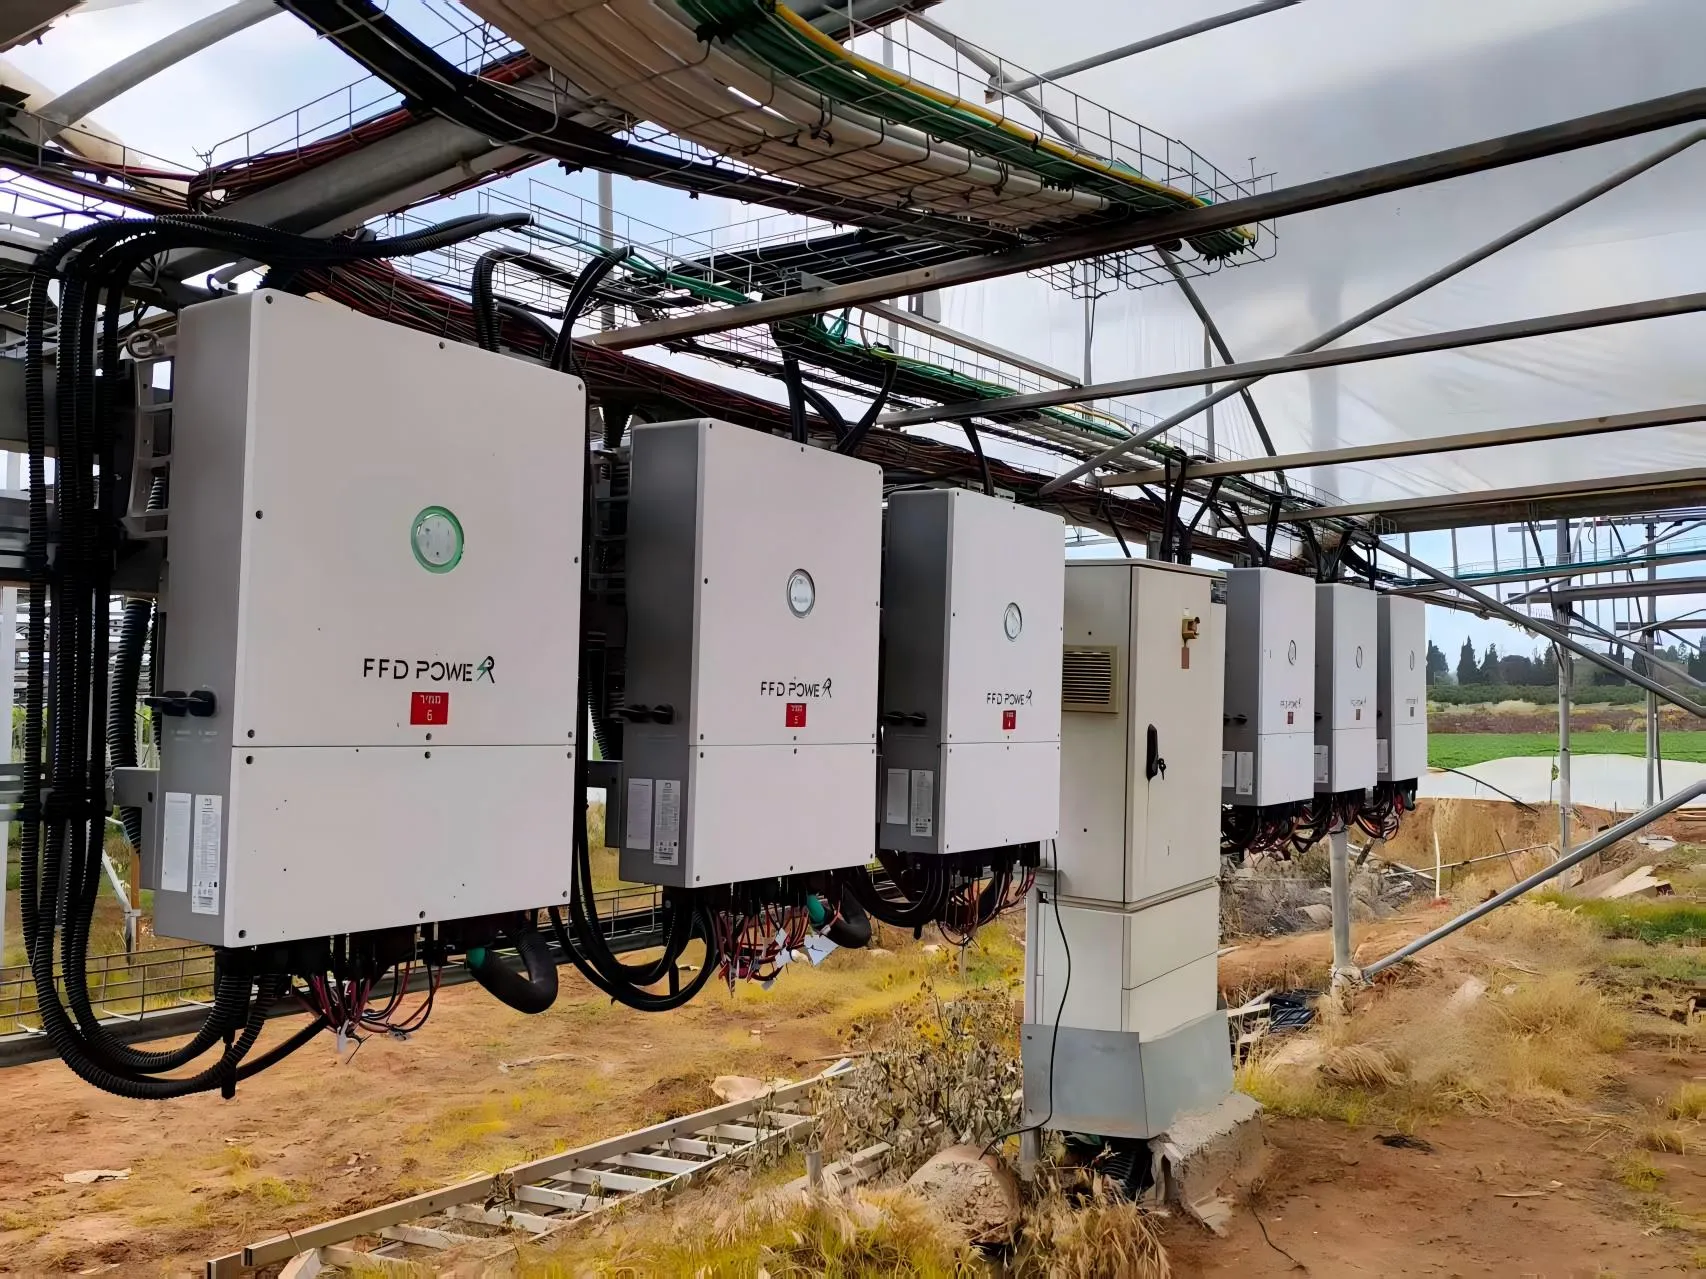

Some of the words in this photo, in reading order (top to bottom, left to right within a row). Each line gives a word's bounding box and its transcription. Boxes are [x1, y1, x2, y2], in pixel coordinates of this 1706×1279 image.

[363, 658, 409, 680] FFD
[416, 655, 495, 684] POWER
[760, 681, 786, 697] FFD
[788, 677, 832, 699] POWER
[986, 692, 1003, 705] FFD
[1004, 689, 1033, 706] POWER
[426, 709, 433, 721] 6
